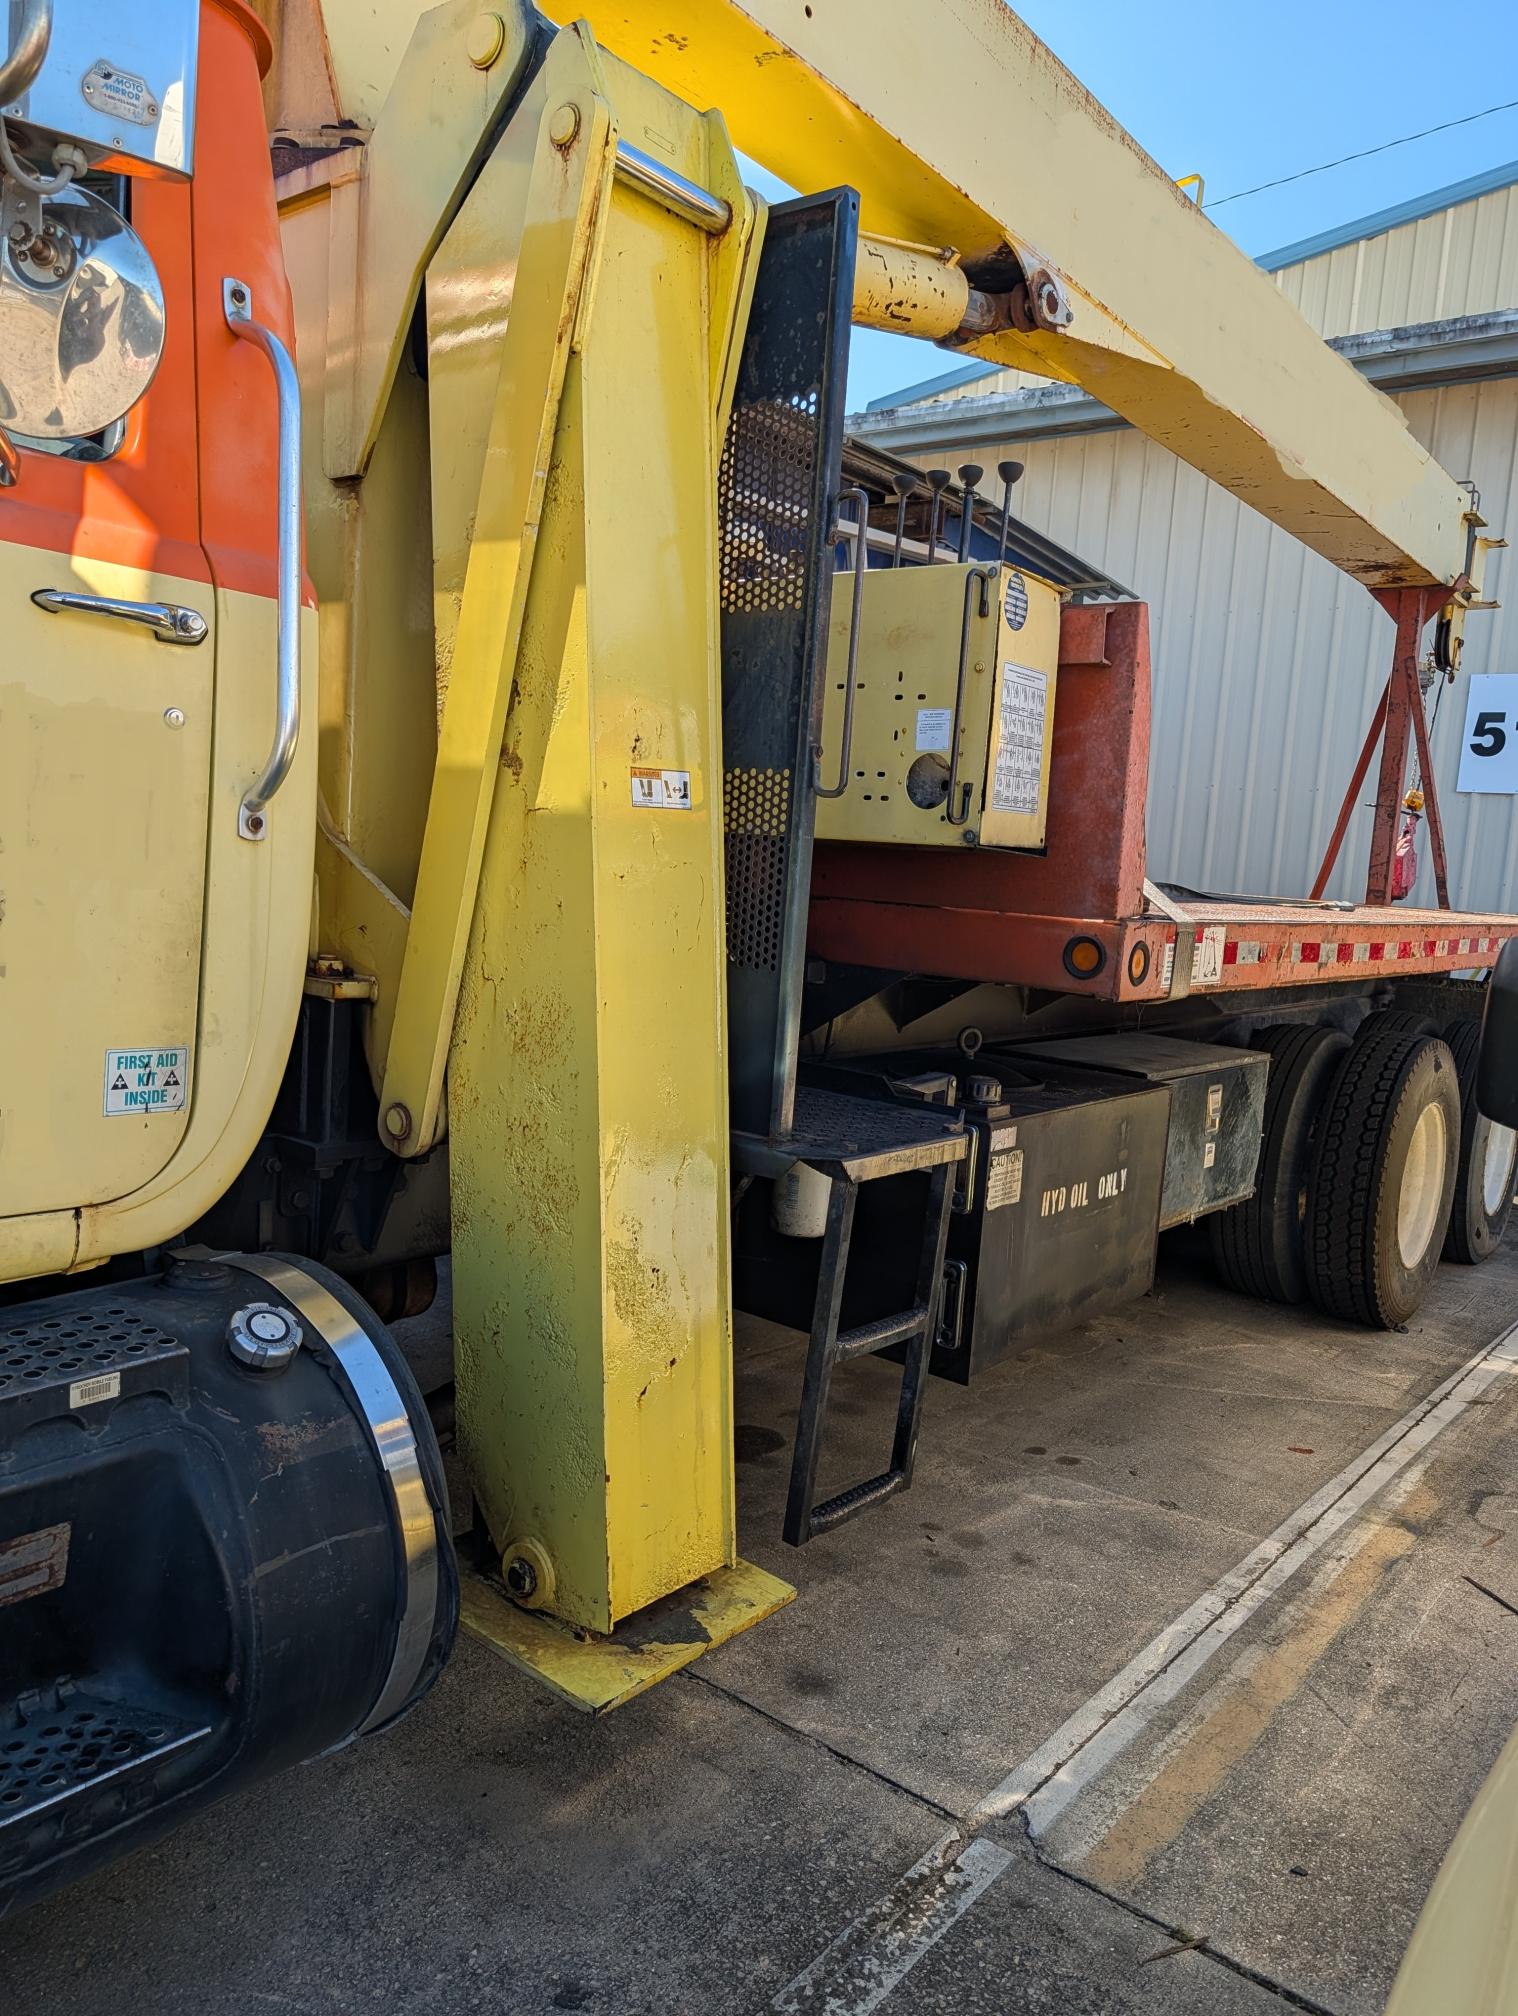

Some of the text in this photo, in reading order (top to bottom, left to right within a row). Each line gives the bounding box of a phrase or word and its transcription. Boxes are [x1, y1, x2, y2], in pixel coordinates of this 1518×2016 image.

[101, 82, 141, 102] MIRROR
[113, 77, 143, 94] MOTO
[1470, 711, 1518, 757] 5
[117, 1052, 178, 1070] FIRST AID
[124, 1089, 168, 1106] INSIDE
[1041, 1186, 1066, 1217] HYD
[1070, 1181, 1089, 1209] OIL
[1098, 1167, 1128, 1200] ONLY
